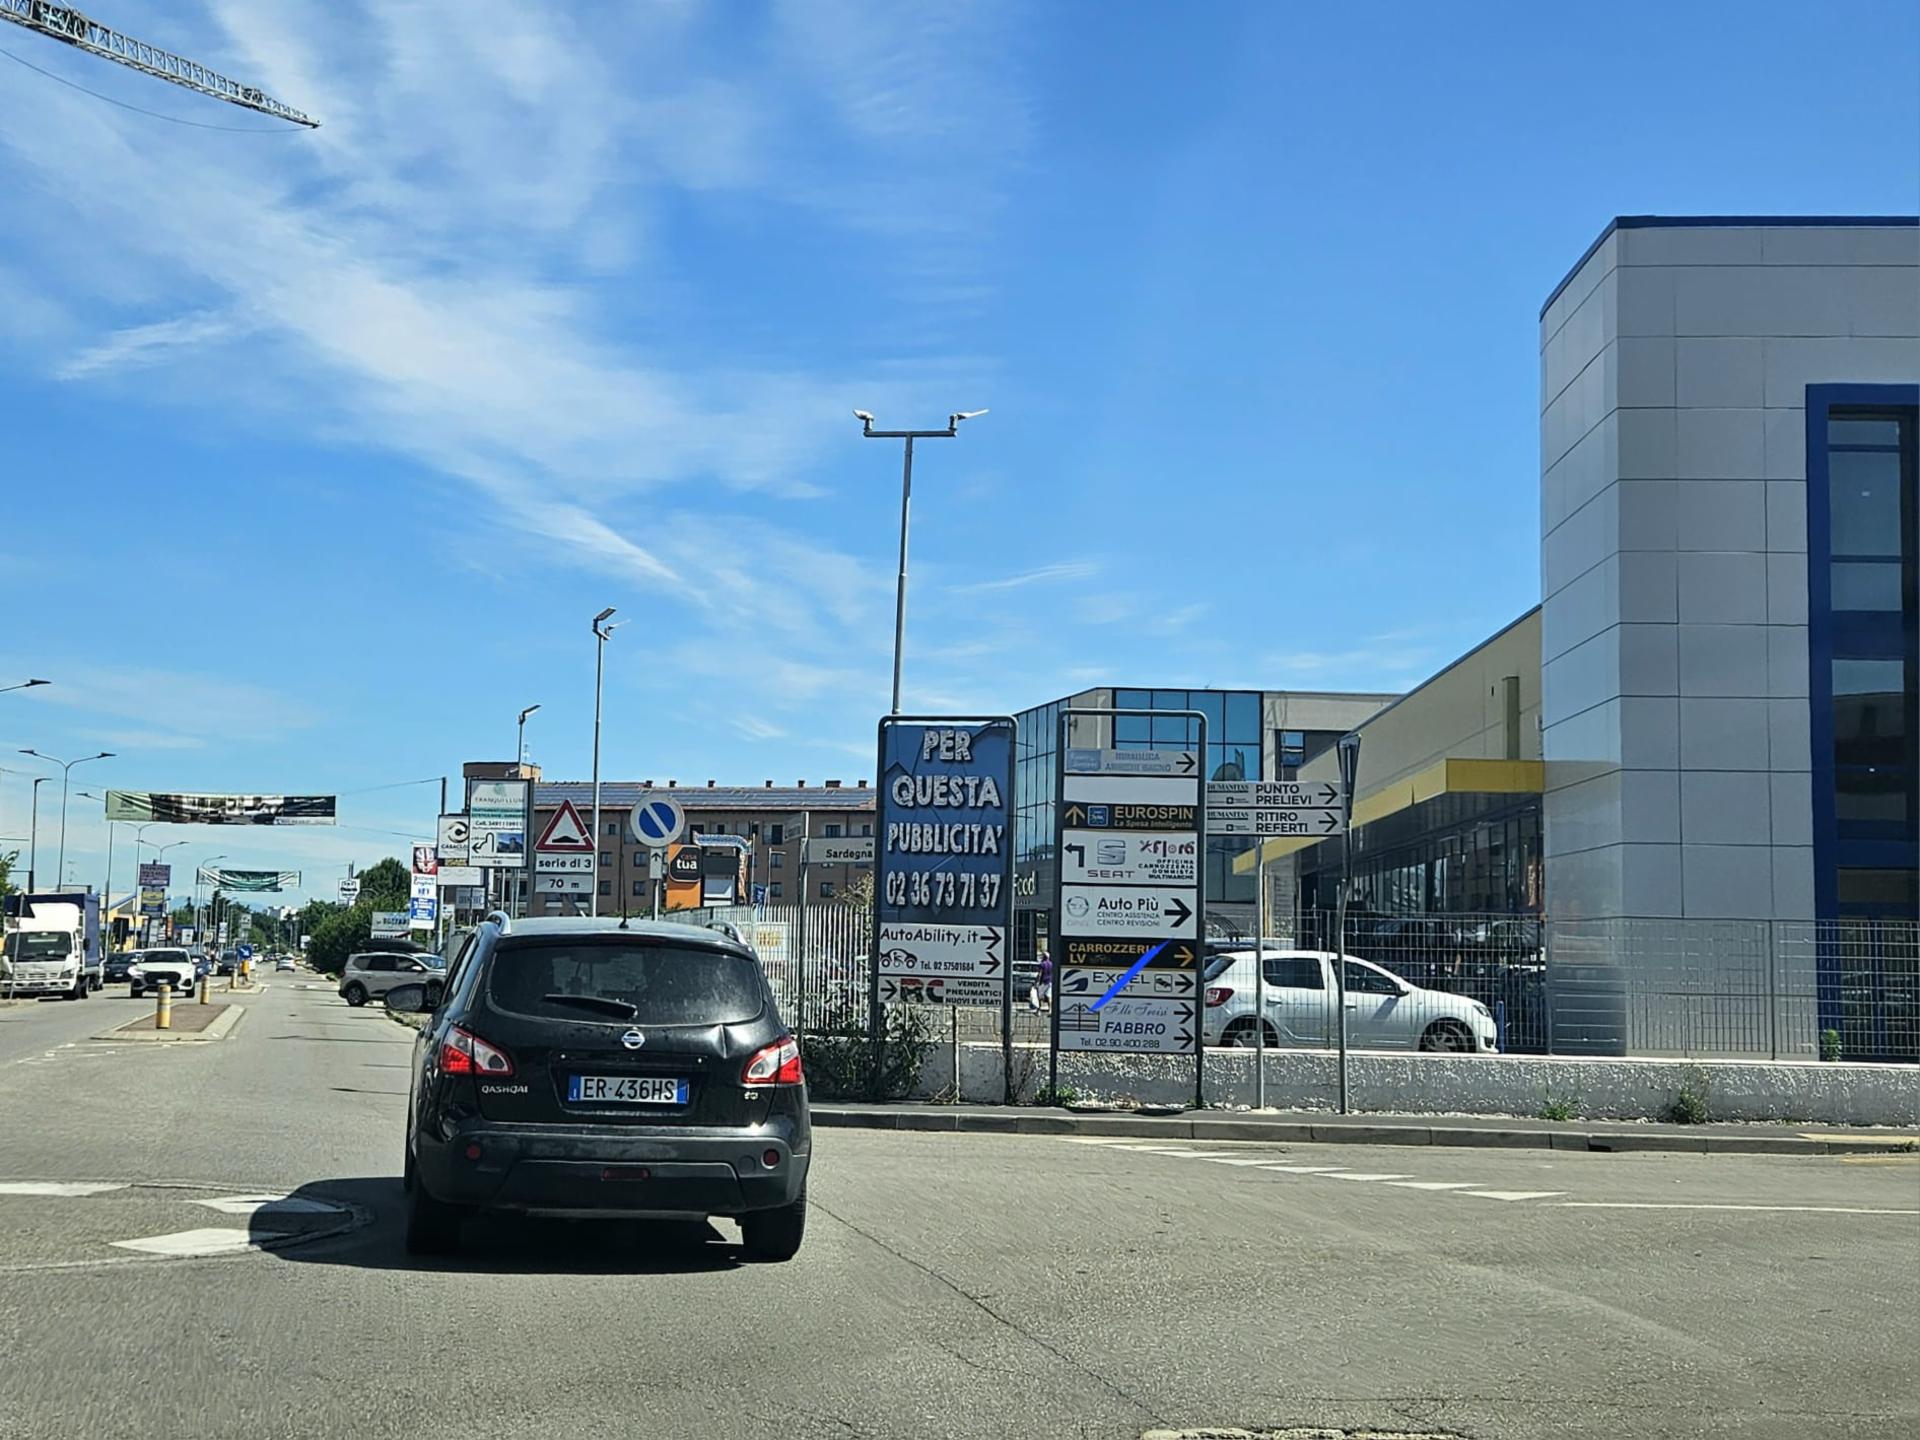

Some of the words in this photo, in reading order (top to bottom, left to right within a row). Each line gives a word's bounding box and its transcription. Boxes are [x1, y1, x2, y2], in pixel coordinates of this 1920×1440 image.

[923, 730, 971, 760] PER
[892, 775, 1000, 807] QUESTA
[1256, 784, 1299, 794] PUNTO
[1256, 795, 1311, 805] PRELIEVI
[1115, 806, 1193, 819] EUROSPIN
[1256, 812, 1298, 822] RITIRO
[1256, 823, 1308, 832] REFERTI
[887, 822, 1002, 854] PUBBLICITA'
[826, 849, 873, 860] Sardegna
[538, 858, 567, 867] serie
[570, 858, 581, 867] di
[584, 859, 592, 868] 3
[676, 859, 698, 870] tua
[1088, 870, 1135, 878] SEAT
[549, 879, 564, 888] 70
[886, 871, 906, 906] 02
[910, 871, 930, 906] 36
[936, 872, 955, 907] 73
[960, 872, 975, 908] 71
[979, 873, 1000, 908] 37
[1098, 897, 1132, 910] Auto
[1137, 896, 1158, 911] Più
[1127, 919, 1160, 927] REVISIONI
[880, 928, 978, 946] AutoAbility.it
[1069, 953, 1086, 964] LV
[946, 988, 1002, 997] PNEUMATICI
[1105, 1022, 1166, 1034] FABBRO
[482, 1085, 528, 1094] QASHQAI
